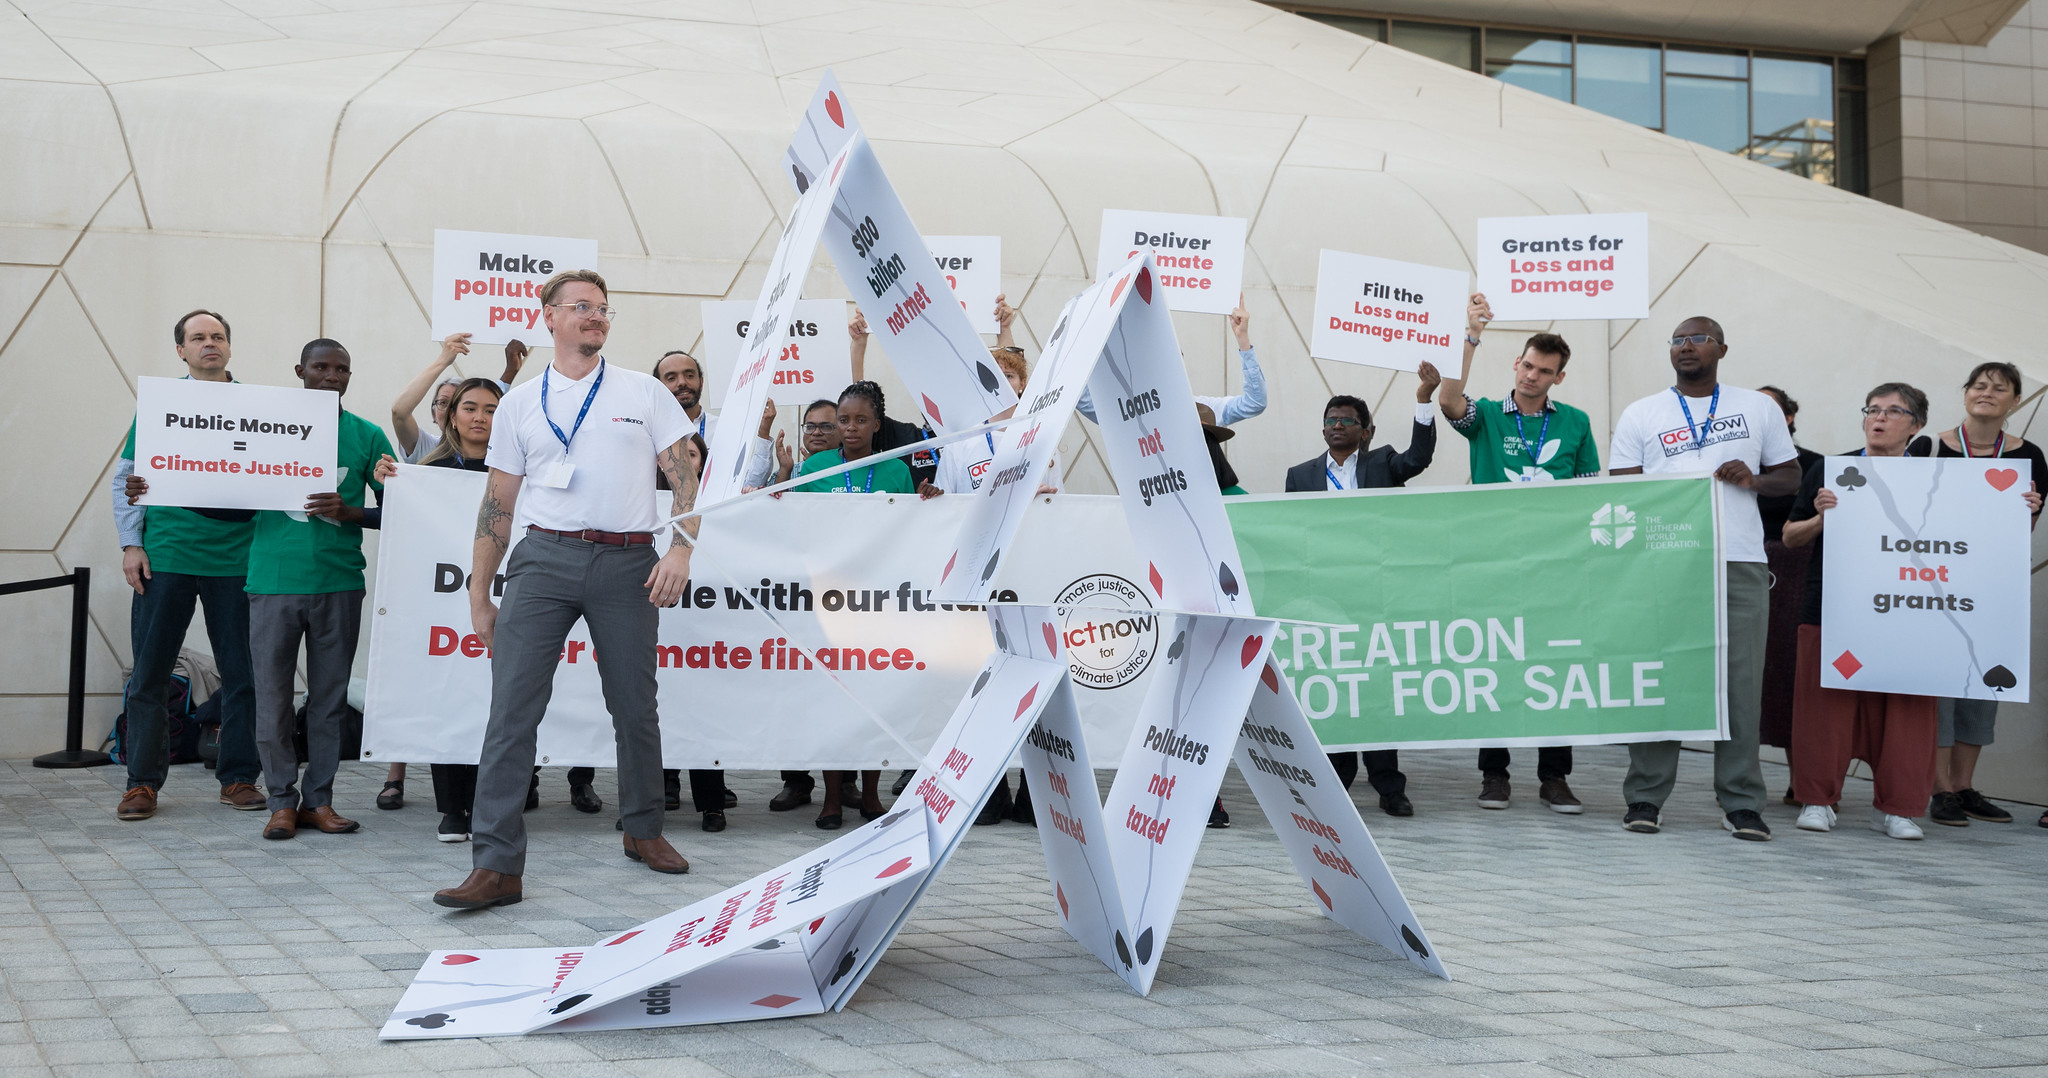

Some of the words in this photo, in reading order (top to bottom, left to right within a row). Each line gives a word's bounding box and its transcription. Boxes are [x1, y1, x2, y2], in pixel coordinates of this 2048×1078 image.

[851, 215, 879, 260] $100
[1134, 231, 1211, 250] Deliver
[1502, 237, 1584, 253] Grants
[1588, 235, 1623, 251] for
[479, 252, 554, 274] Make
[1128, 249, 1213, 270] mate
[1510, 258, 1562, 273] Loss
[1567, 255, 1614, 271] and
[866, 252, 906, 299] billion
[1160, 274, 1211, 290] ance
[1511, 279, 1614, 297] Damage
[1363, 282, 1390, 299] Fill
[1393, 287, 1424, 304] the
[489, 306, 541, 330] pay
[886, 303, 910, 336] not
[903, 281, 932, 320] met
[1354, 301, 1392, 318] Loss
[1395, 309, 1429, 324] and
[1329, 316, 1404, 342] Damage
[1407, 328, 1450, 347] Fund
[780, 343, 800, 360] ot
[772, 369, 815, 385] ans
[1028, 385, 1064, 414] Loans
[1118, 388, 1161, 421] Loans
[165, 413, 236, 431] Public
[239, 418, 313, 440] Money
[1016, 422, 1041, 450] not
[1717, 430, 1746, 442] justice
[233, 441, 246, 451] =
[1138, 428, 1164, 457] not
[150, 454, 241, 473] Climate
[245, 461, 324, 478] Justice
[988, 459, 1031, 496] grants
[1139, 467, 1188, 506] grants
[1645, 516, 1662, 524] THE
[1645, 523, 1692, 533] LUTHERAN
[1645, 532, 1677, 541] WORLD
[1645, 540, 1700, 550] FEDERATION
[1881, 535, 1968, 555] Loans
[1899, 565, 1949, 582] not
[724, 578, 813, 612] with
[821, 589, 889, 612] our
[1098, 578, 1135, 599] justice
[1873, 593, 1975, 614] grants
[760, 637, 926, 671] finance.
[1070, 664, 1114, 683] climate
[1116, 649, 1148, 683] justice
[1100, 647, 1115, 658] for
[1392, 667, 1501, 716] FOR
[1524, 661, 1665, 711] SALE
[1143, 725, 1209, 765] Polluters
[939, 747, 974, 781] Fund
[1247, 748, 1317, 788] finance
[1048, 770, 1070, 799] not
[1147, 773, 1176, 800] not
[1049, 803, 1087, 846] taxed
[1126, 804, 1170, 845] taxed
[1290, 811, 1341, 844] more
[1312, 843, 1358, 880] debt
[759, 871, 792, 904] Loss
[786, 858, 830, 905] Empty
[697, 890, 751, 947] Damage
[748, 899, 777, 931] and
[664, 916, 706, 955] Fund
